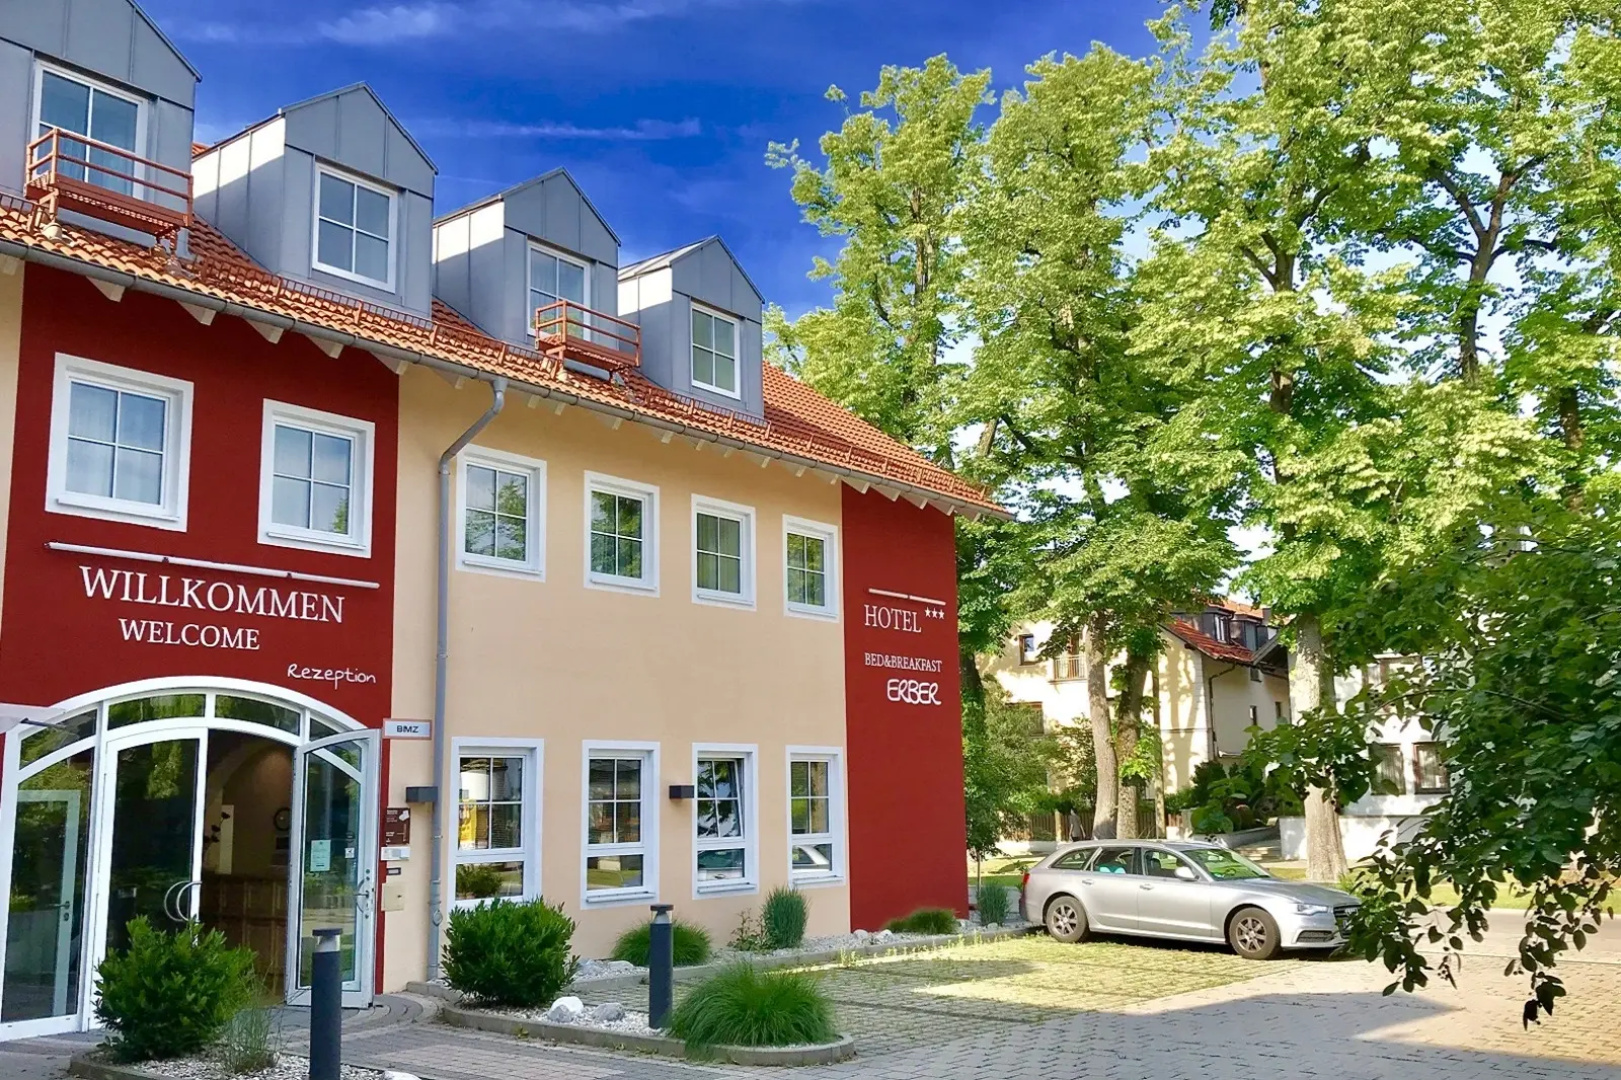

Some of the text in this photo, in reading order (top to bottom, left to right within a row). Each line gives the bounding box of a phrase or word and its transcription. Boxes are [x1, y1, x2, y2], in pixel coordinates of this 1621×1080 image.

[79, 566, 345, 623] WILLKOMMEN
[864, 604, 922, 633] HOTEL
[118, 618, 260, 650] WELCOME
[864, 652, 942, 673] BED&BREAKFAST
[287, 663, 377, 690] Rezeption
[887, 679, 942, 706] ERBER
[396, 724, 419, 734] BMZ
